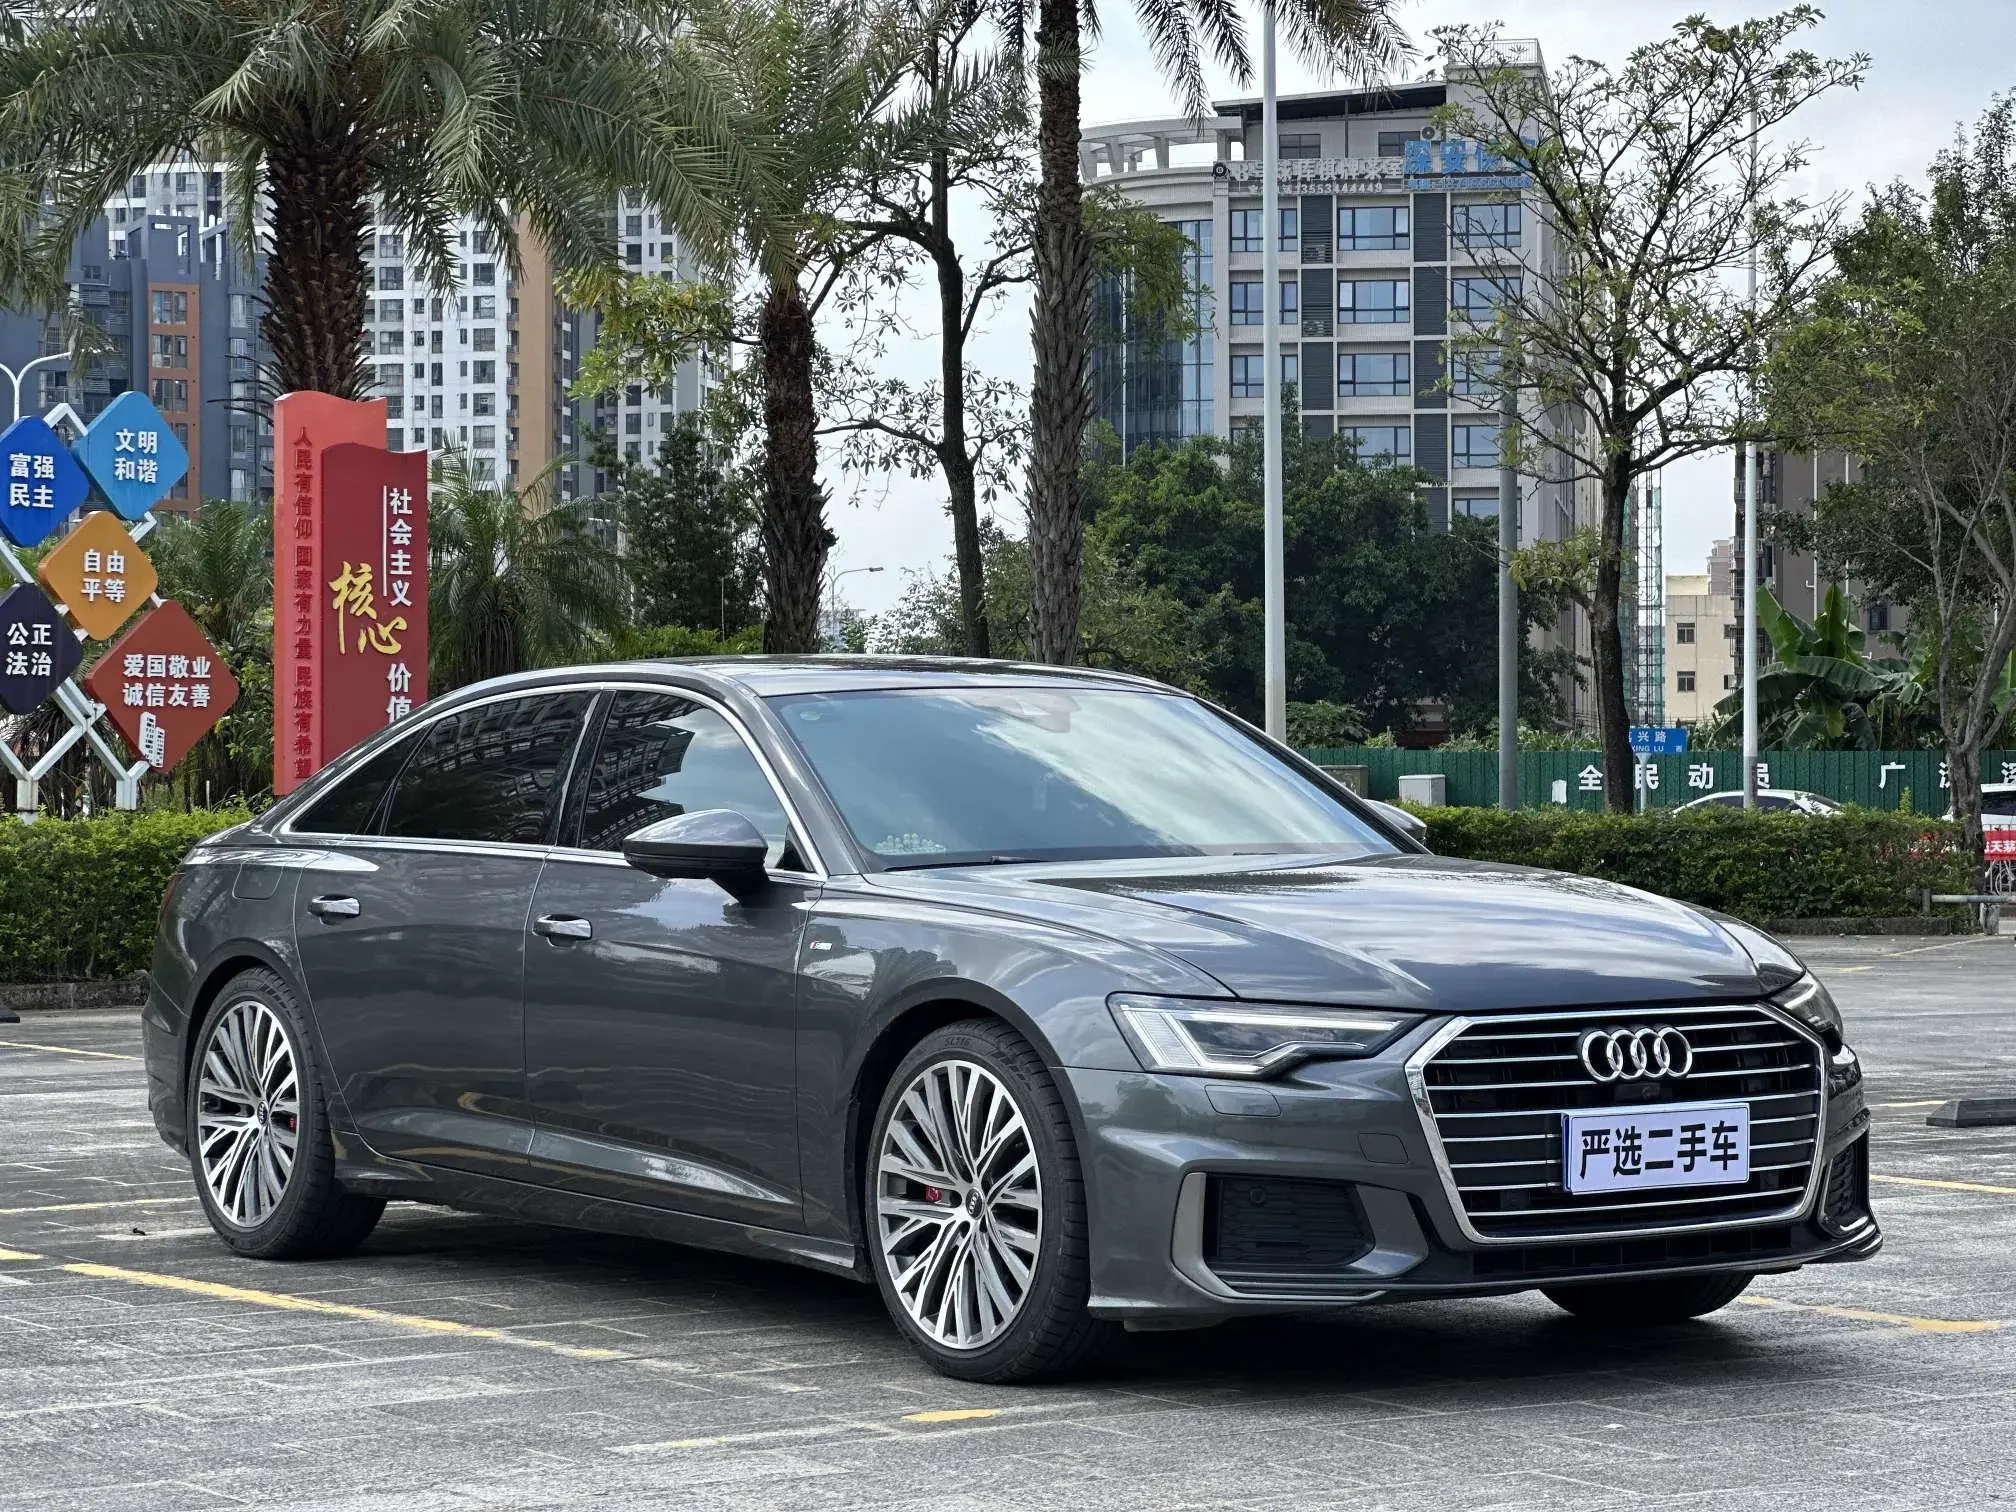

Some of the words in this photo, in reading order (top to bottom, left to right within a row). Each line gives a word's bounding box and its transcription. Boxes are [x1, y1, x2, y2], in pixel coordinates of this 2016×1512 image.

[115, 428, 158, 452] 文明
[9, 454, 56, 480] 富强
[114, 458, 159, 484] 和谐
[294, 426, 313, 540] 人民有信仰
[9, 484, 55, 509] 民主
[389, 488, 413, 607] 社会主义
[82, 550, 126, 573] 自由
[81, 577, 126, 603] 平等
[294, 545, 313, 660] 国家有力量
[328, 561, 408, 655] 核心
[6, 622, 53, 646] 公正
[5, 651, 52, 676] 法治
[122, 654, 211, 679] 爱国敬业
[122, 682, 211, 708] 诚信友善
[294, 665, 313, 779] 民族有希望
[1629, 731, 1667, 743] 兴路
[1579, 1120, 1740, 1179] 严选二手车
